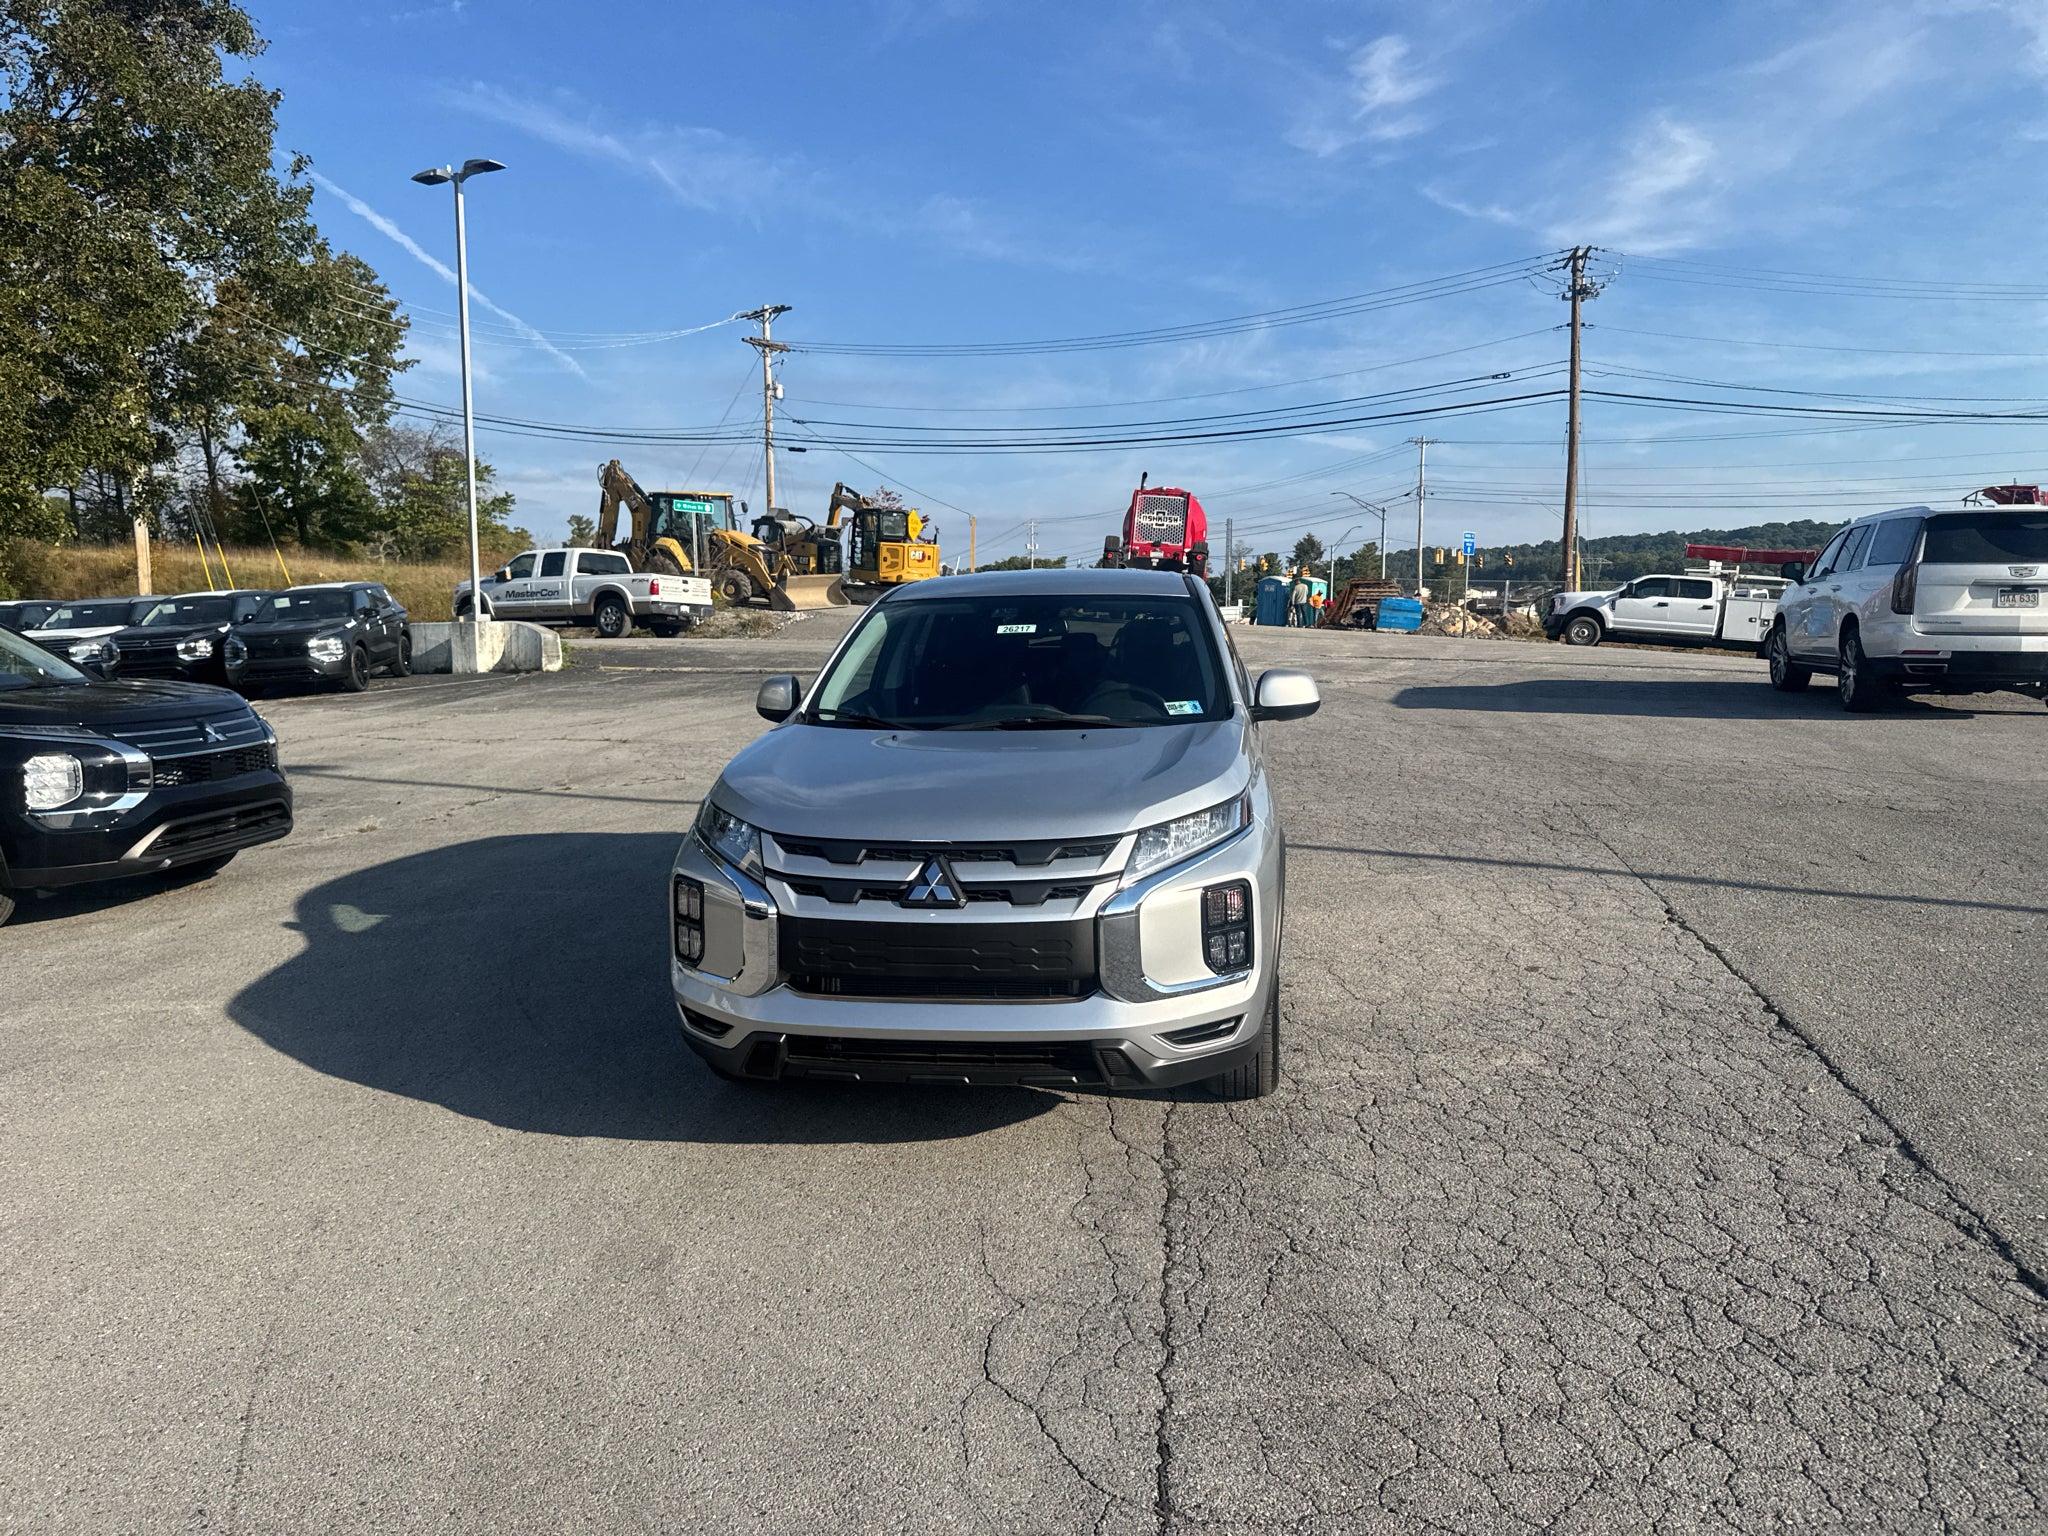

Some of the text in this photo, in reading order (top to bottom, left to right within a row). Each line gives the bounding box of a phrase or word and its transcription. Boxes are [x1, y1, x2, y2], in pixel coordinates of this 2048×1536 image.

[1142, 515, 1179, 523] OSHKOSH
[910, 550, 923, 560] CAT
[505, 588, 560, 599] MasterCon
[2019, 593, 2037, 603] 633
[1002, 625, 1031, 633] 26217
